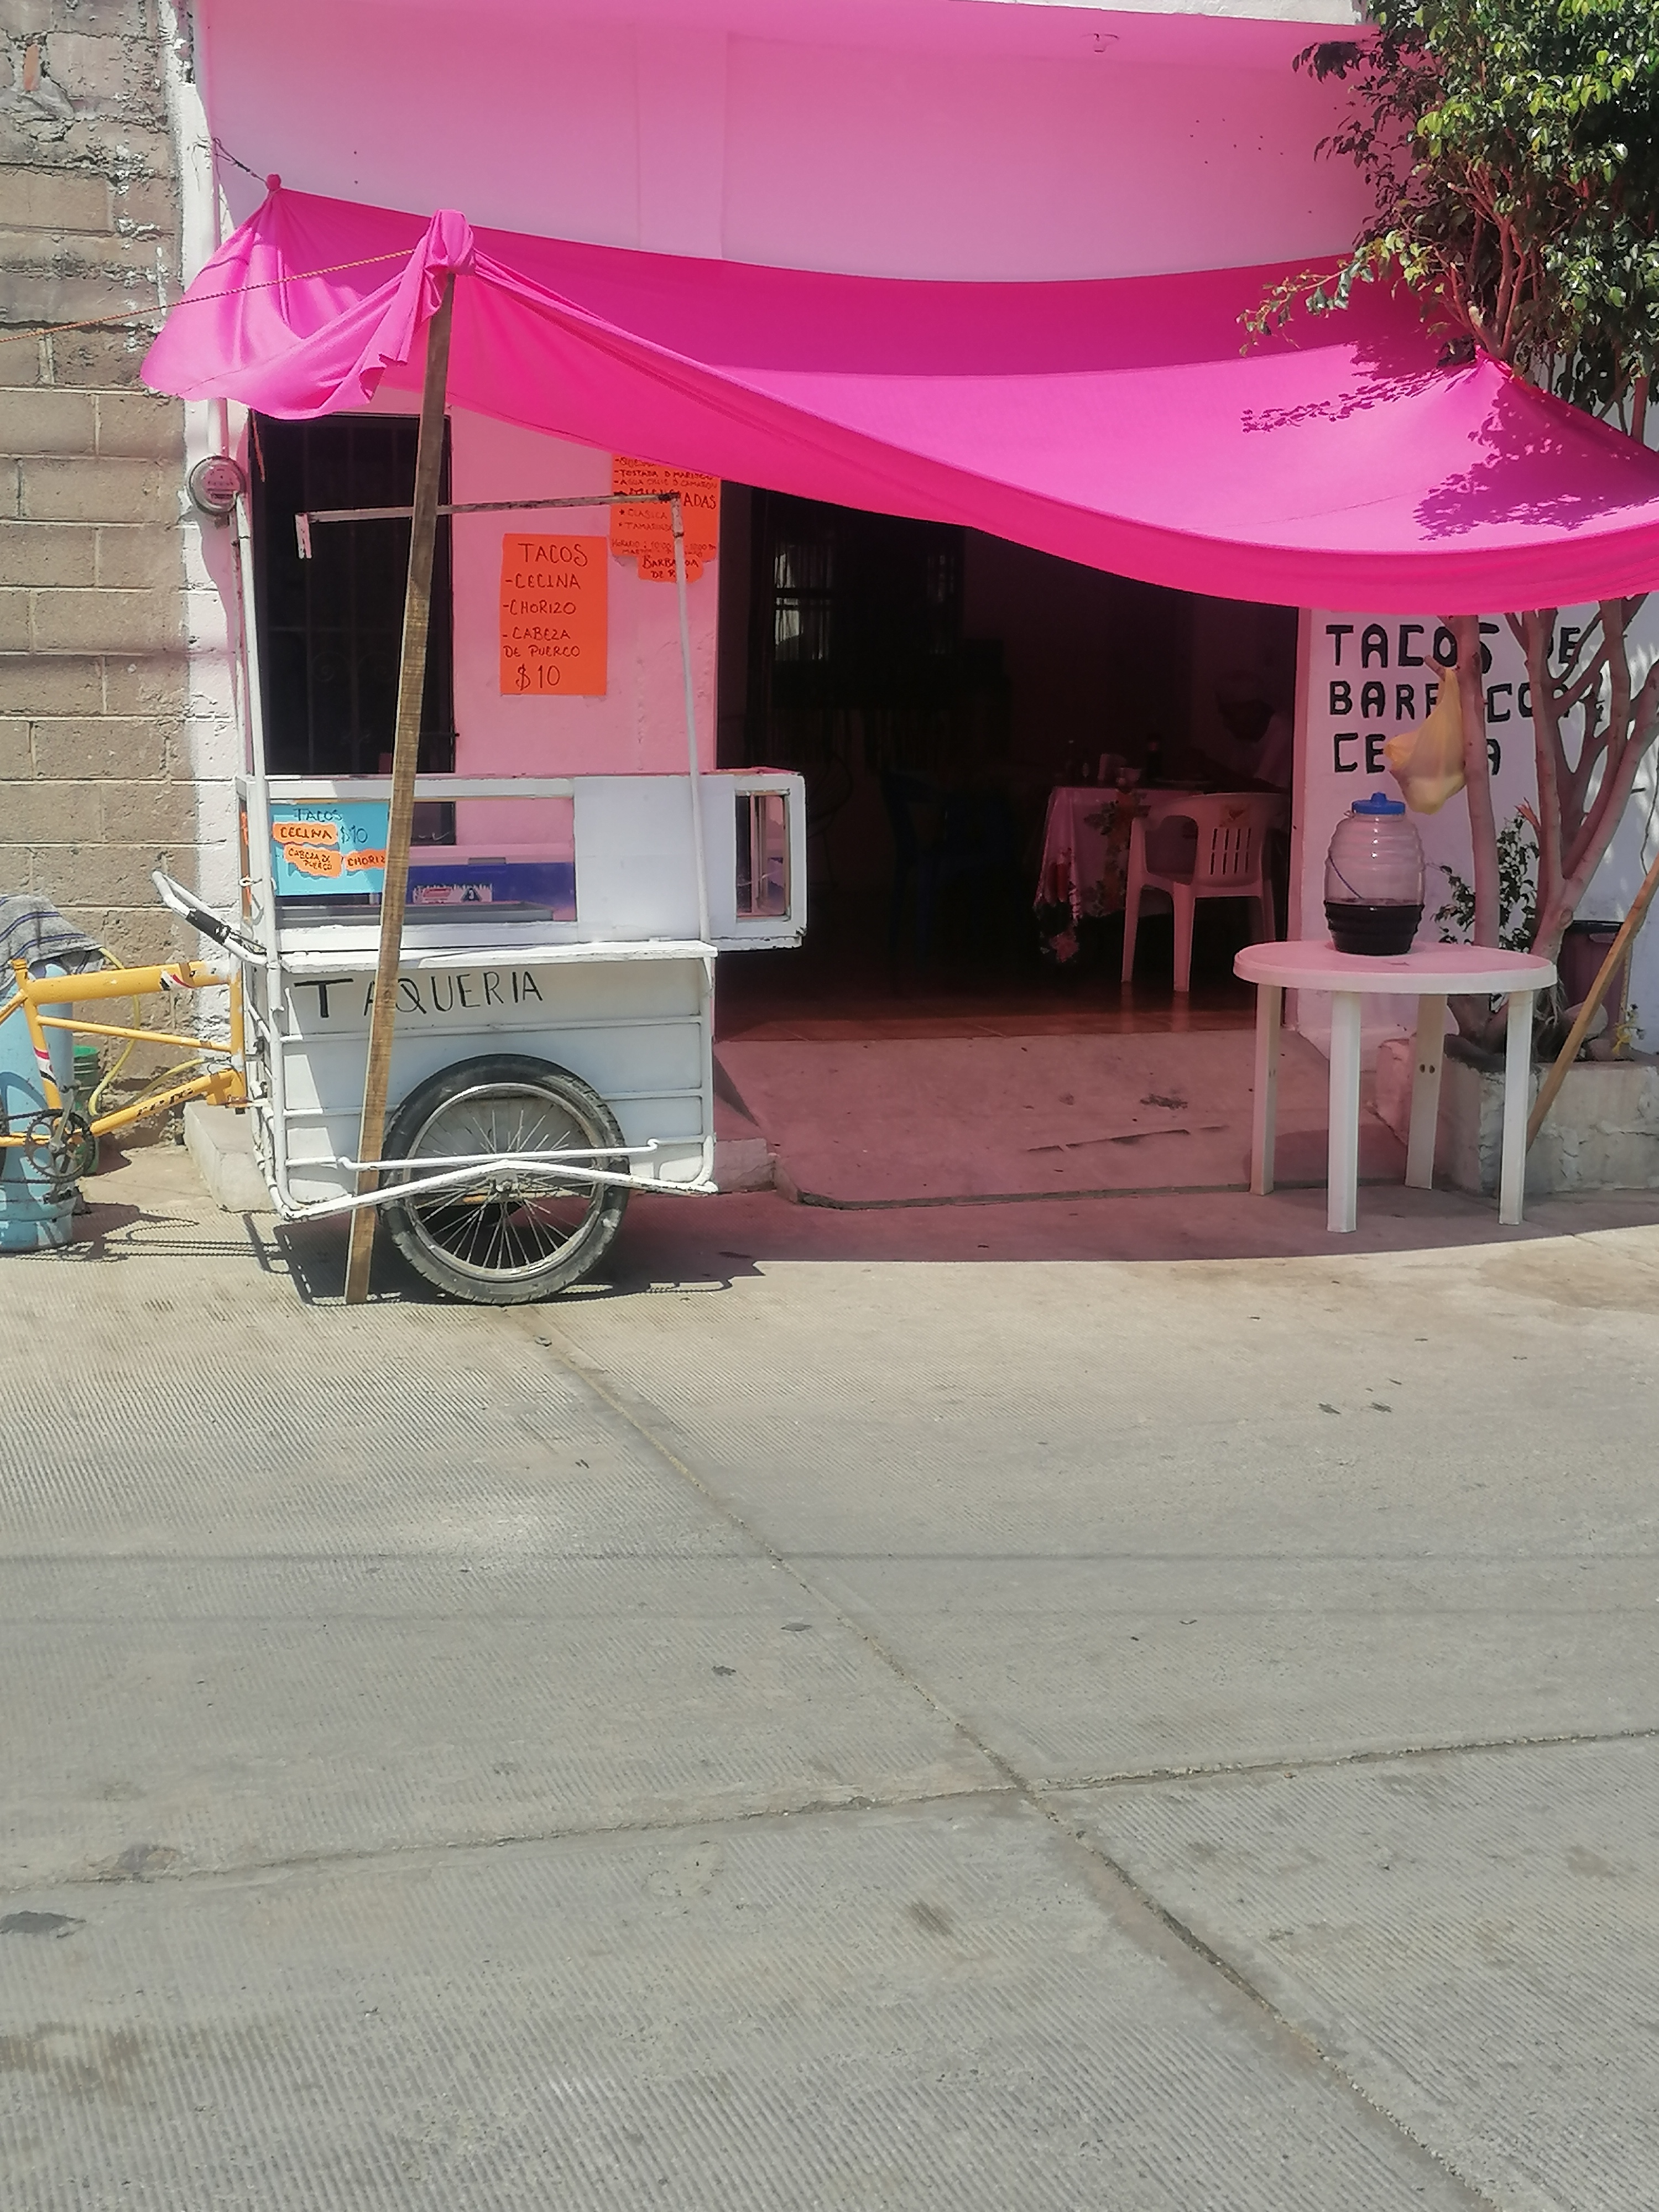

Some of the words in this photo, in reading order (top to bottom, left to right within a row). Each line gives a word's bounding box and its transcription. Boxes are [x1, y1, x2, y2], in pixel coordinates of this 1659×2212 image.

[518, 542, 588, 567] TACOS
[503, 645, 521, 658] DE
[528, 644, 581, 658] PUERCO
[293, 808, 343, 823] TACOS
[280, 826, 332, 839] CECINA
[340, 825, 368, 844] $10
[347, 854, 385, 867] CHORIZ
